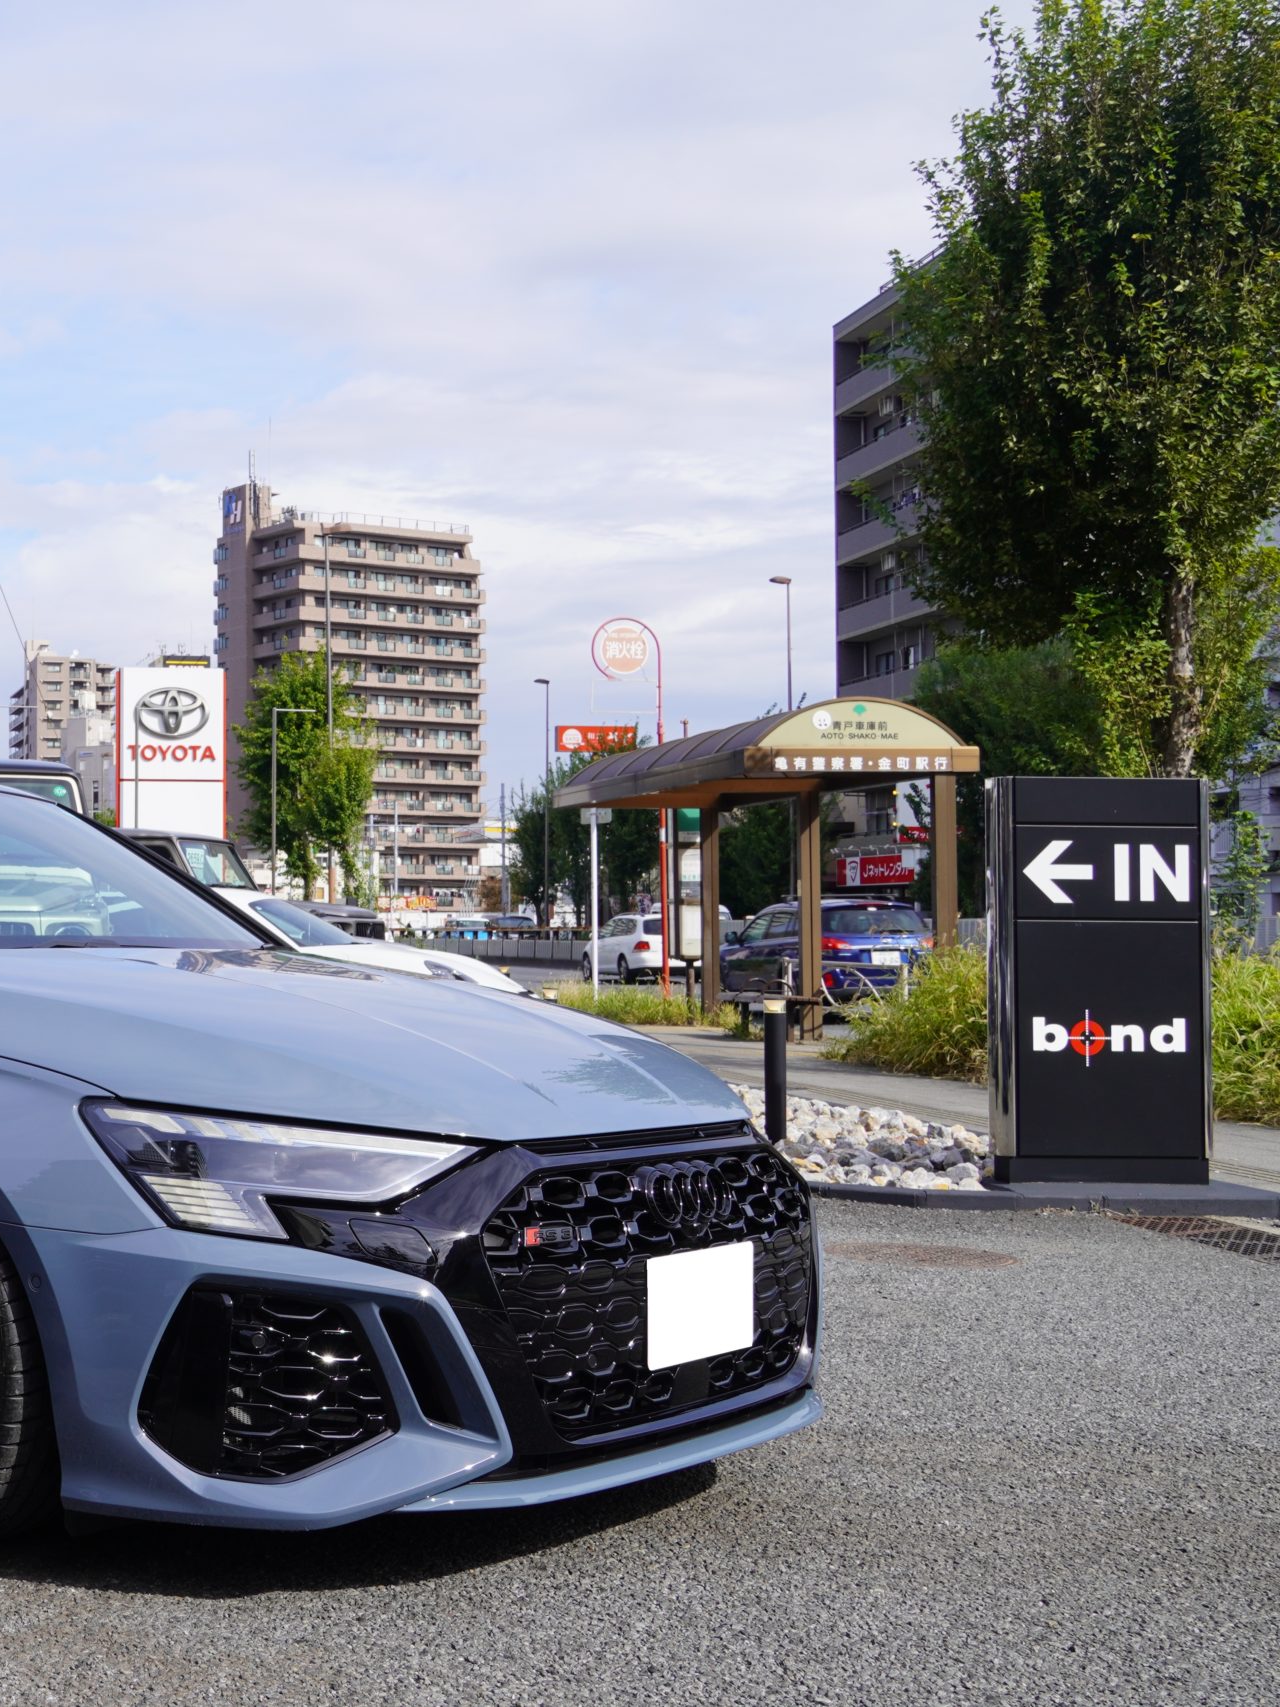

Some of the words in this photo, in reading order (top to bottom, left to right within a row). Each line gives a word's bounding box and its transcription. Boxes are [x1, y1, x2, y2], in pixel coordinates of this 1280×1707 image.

[606, 640, 644, 659] 消火栓
[832, 721, 888, 732] 青戸車庫前
[127, 744, 216, 762] TOYOTA
[1113, 843, 1191, 902] IN
[1032, 1014, 1187, 1058] bond
